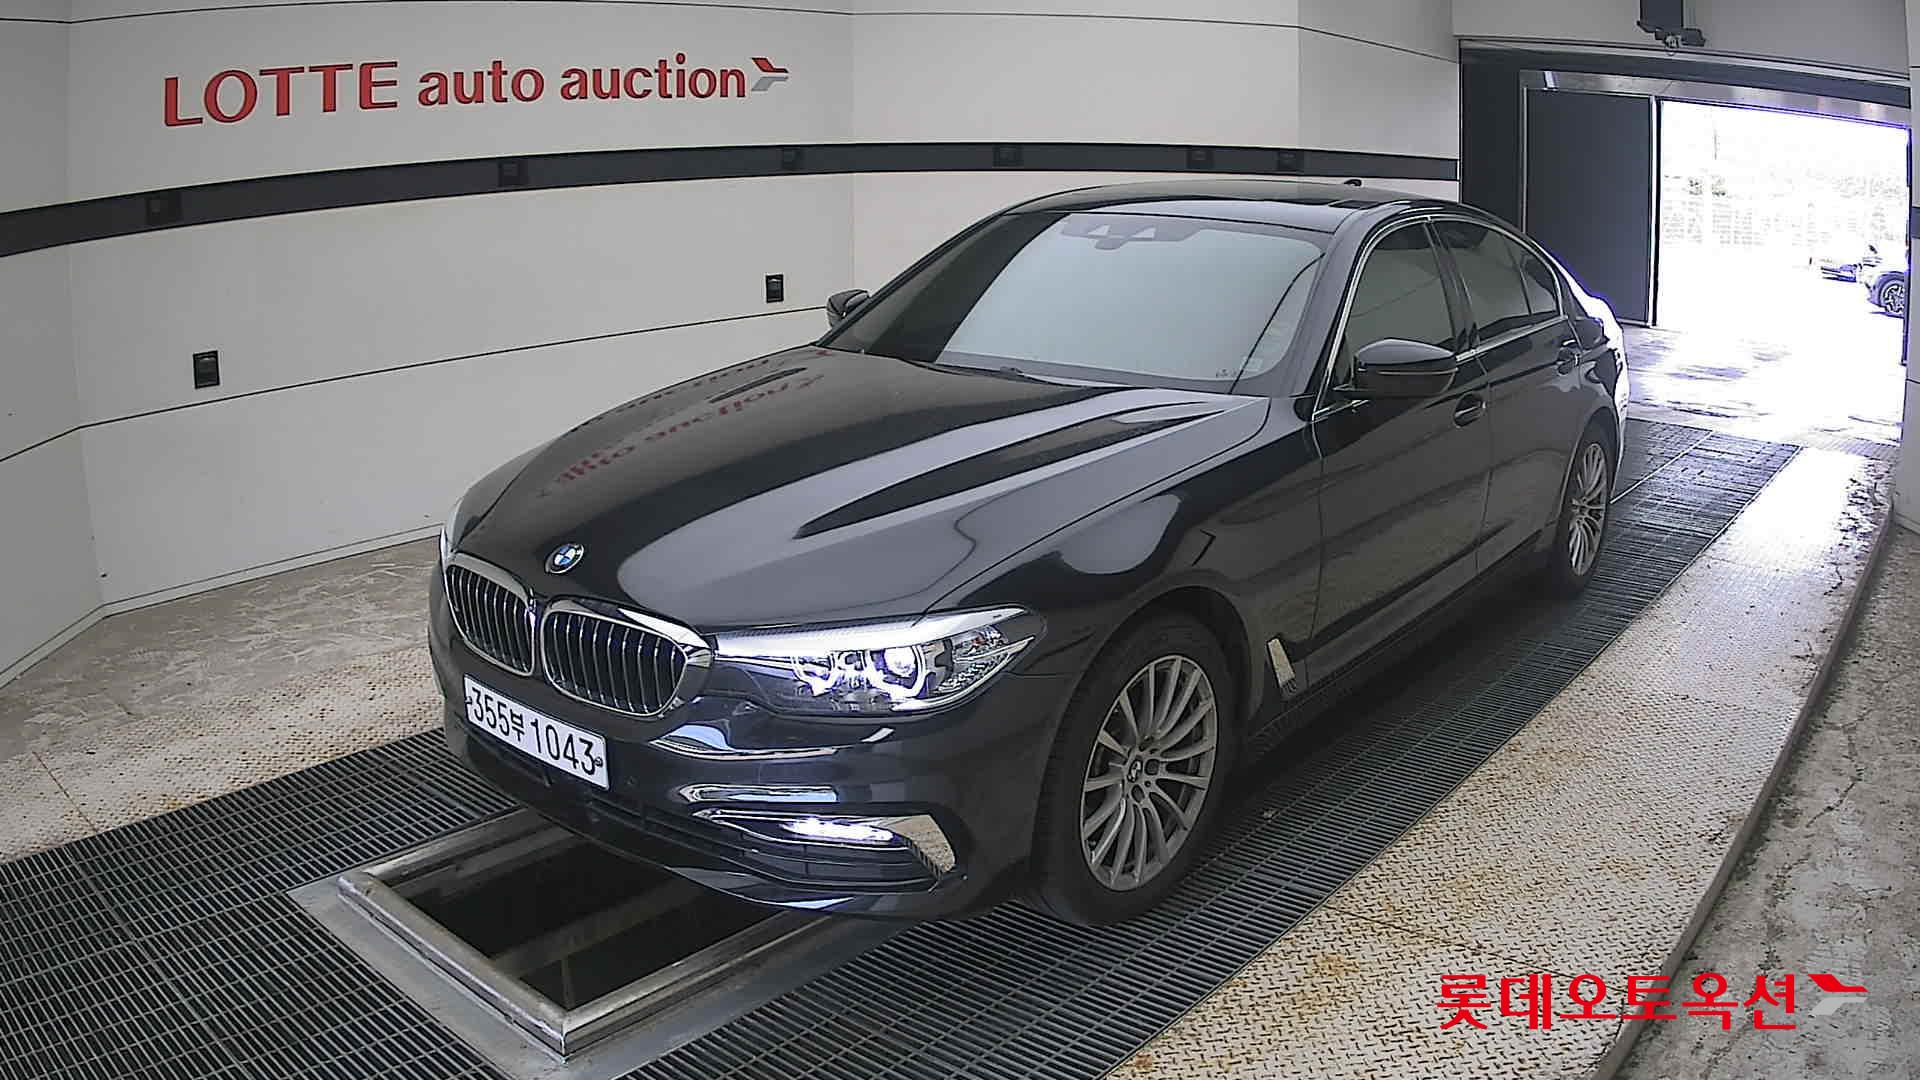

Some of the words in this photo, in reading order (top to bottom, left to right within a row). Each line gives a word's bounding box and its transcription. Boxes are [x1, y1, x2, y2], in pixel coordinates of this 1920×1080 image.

[164, 61, 398, 127] LOTTE
[418, 60, 544, 106] auto
[560, 53, 746, 100] auction
[471, 687, 526, 742] 355부
[530, 718, 596, 776] 1043
